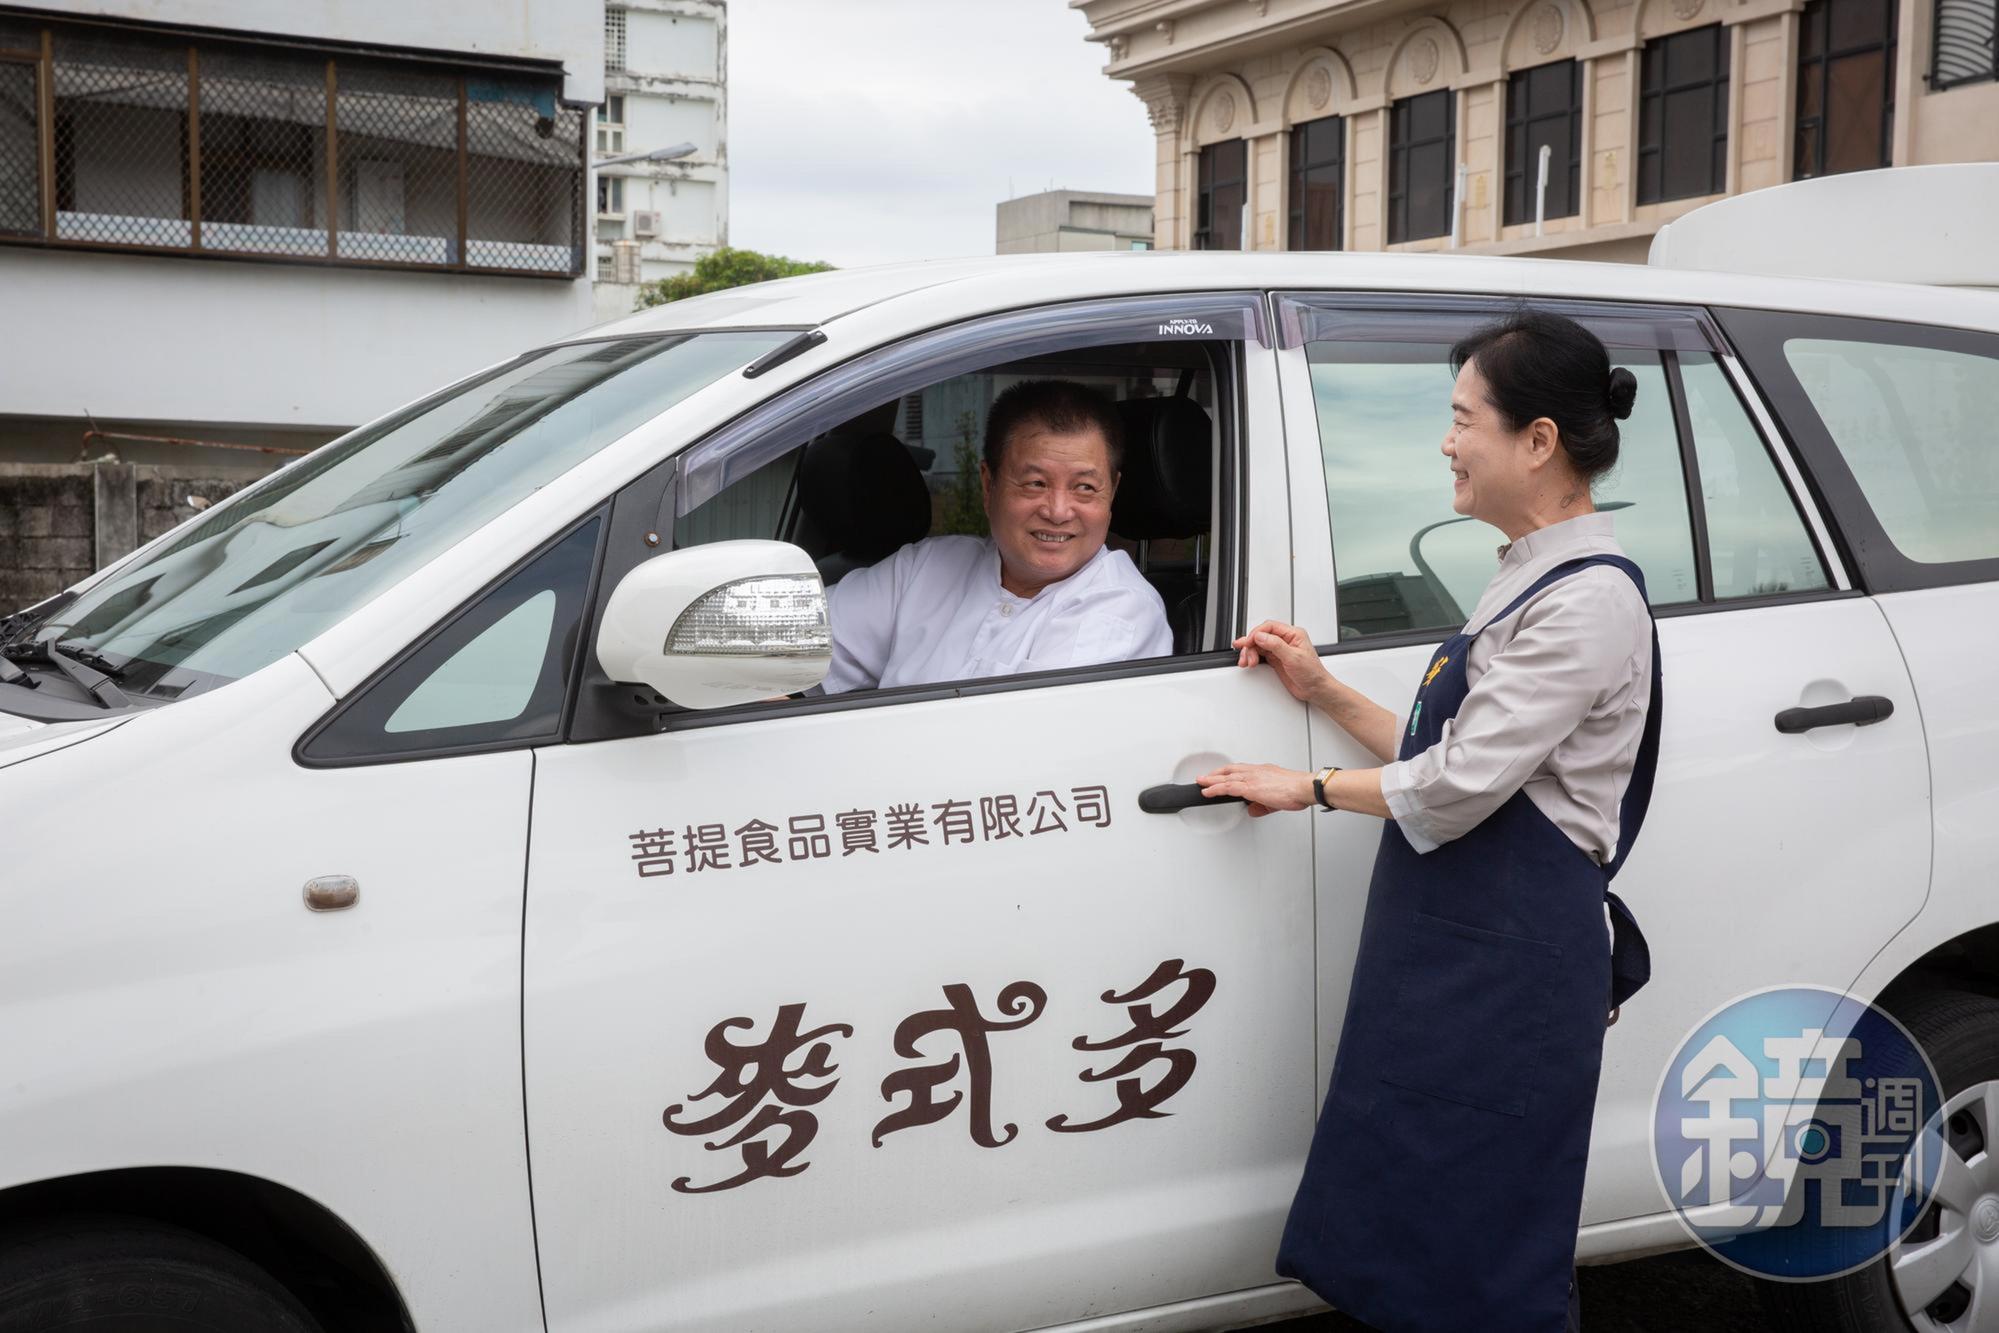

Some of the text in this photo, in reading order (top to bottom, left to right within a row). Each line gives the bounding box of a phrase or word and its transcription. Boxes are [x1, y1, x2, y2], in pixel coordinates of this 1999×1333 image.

[1159, 324, 1214, 335] INNOVA
[629, 785, 1112, 877] 菩提食品實業有限公司
